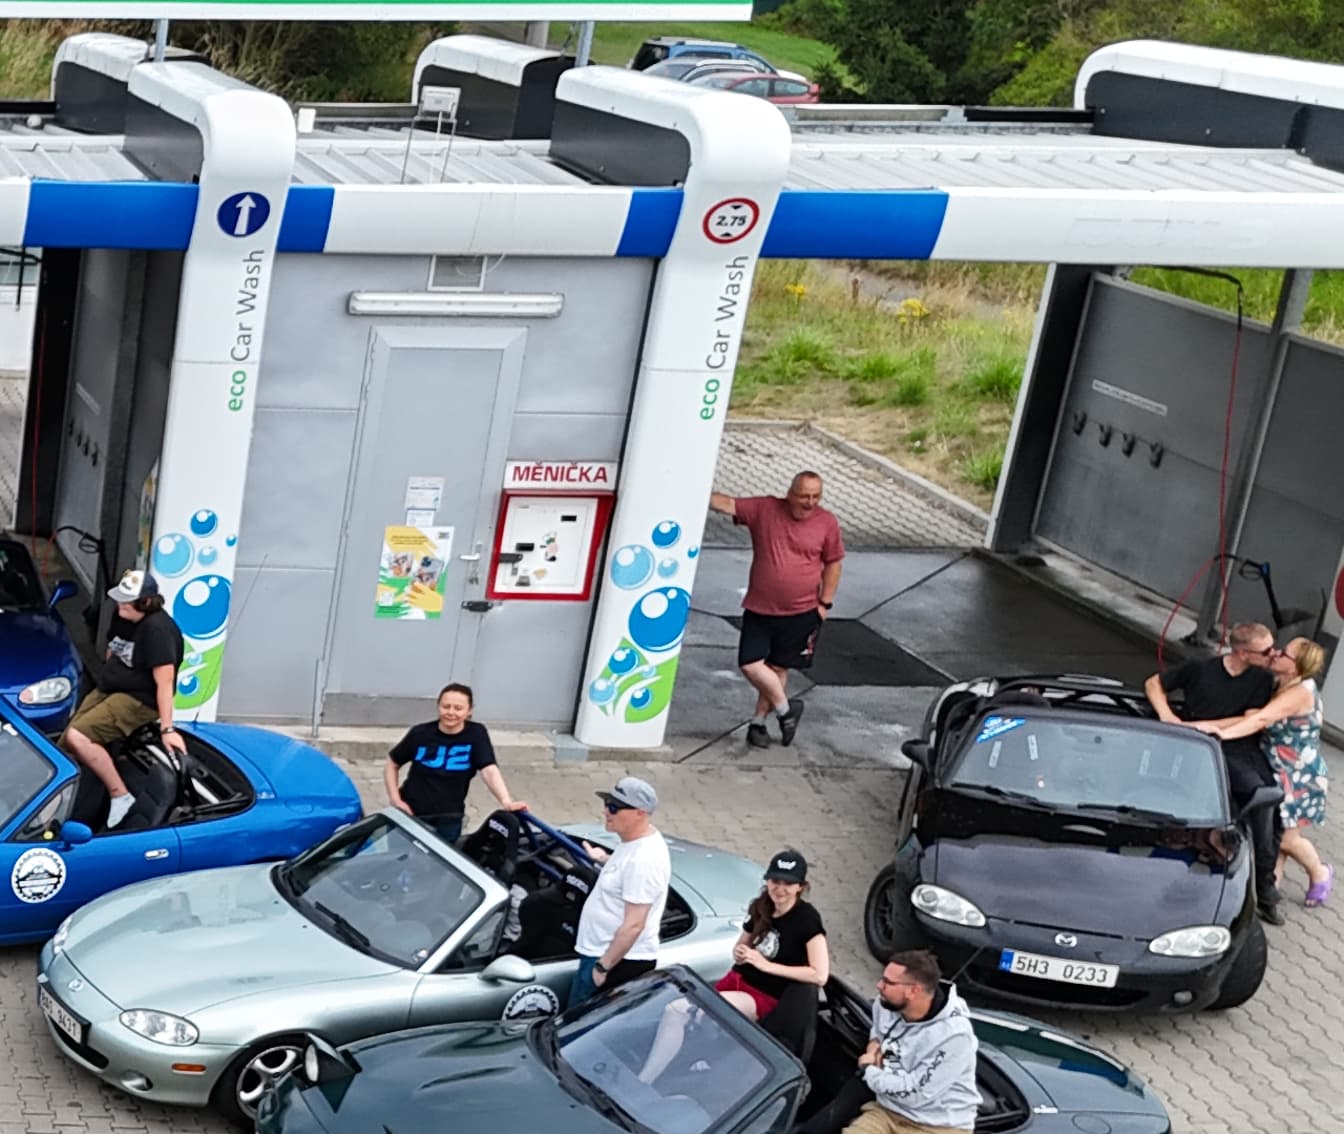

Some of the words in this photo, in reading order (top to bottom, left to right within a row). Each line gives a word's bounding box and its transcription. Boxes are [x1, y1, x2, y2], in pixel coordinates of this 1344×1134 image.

[716, 215, 747, 227] 2.75
[236, 250, 264, 315] Wash
[715, 255, 748, 321] Wash
[230, 322, 253, 361] Car
[706, 329, 731, 369] Car
[228, 370, 247, 411] eco
[700, 378, 720, 420] eco
[512, 460, 608, 483] MĚNIČKA
[1016, 956, 1049, 975] 5H3
[1063, 964, 1108, 983] 0233
